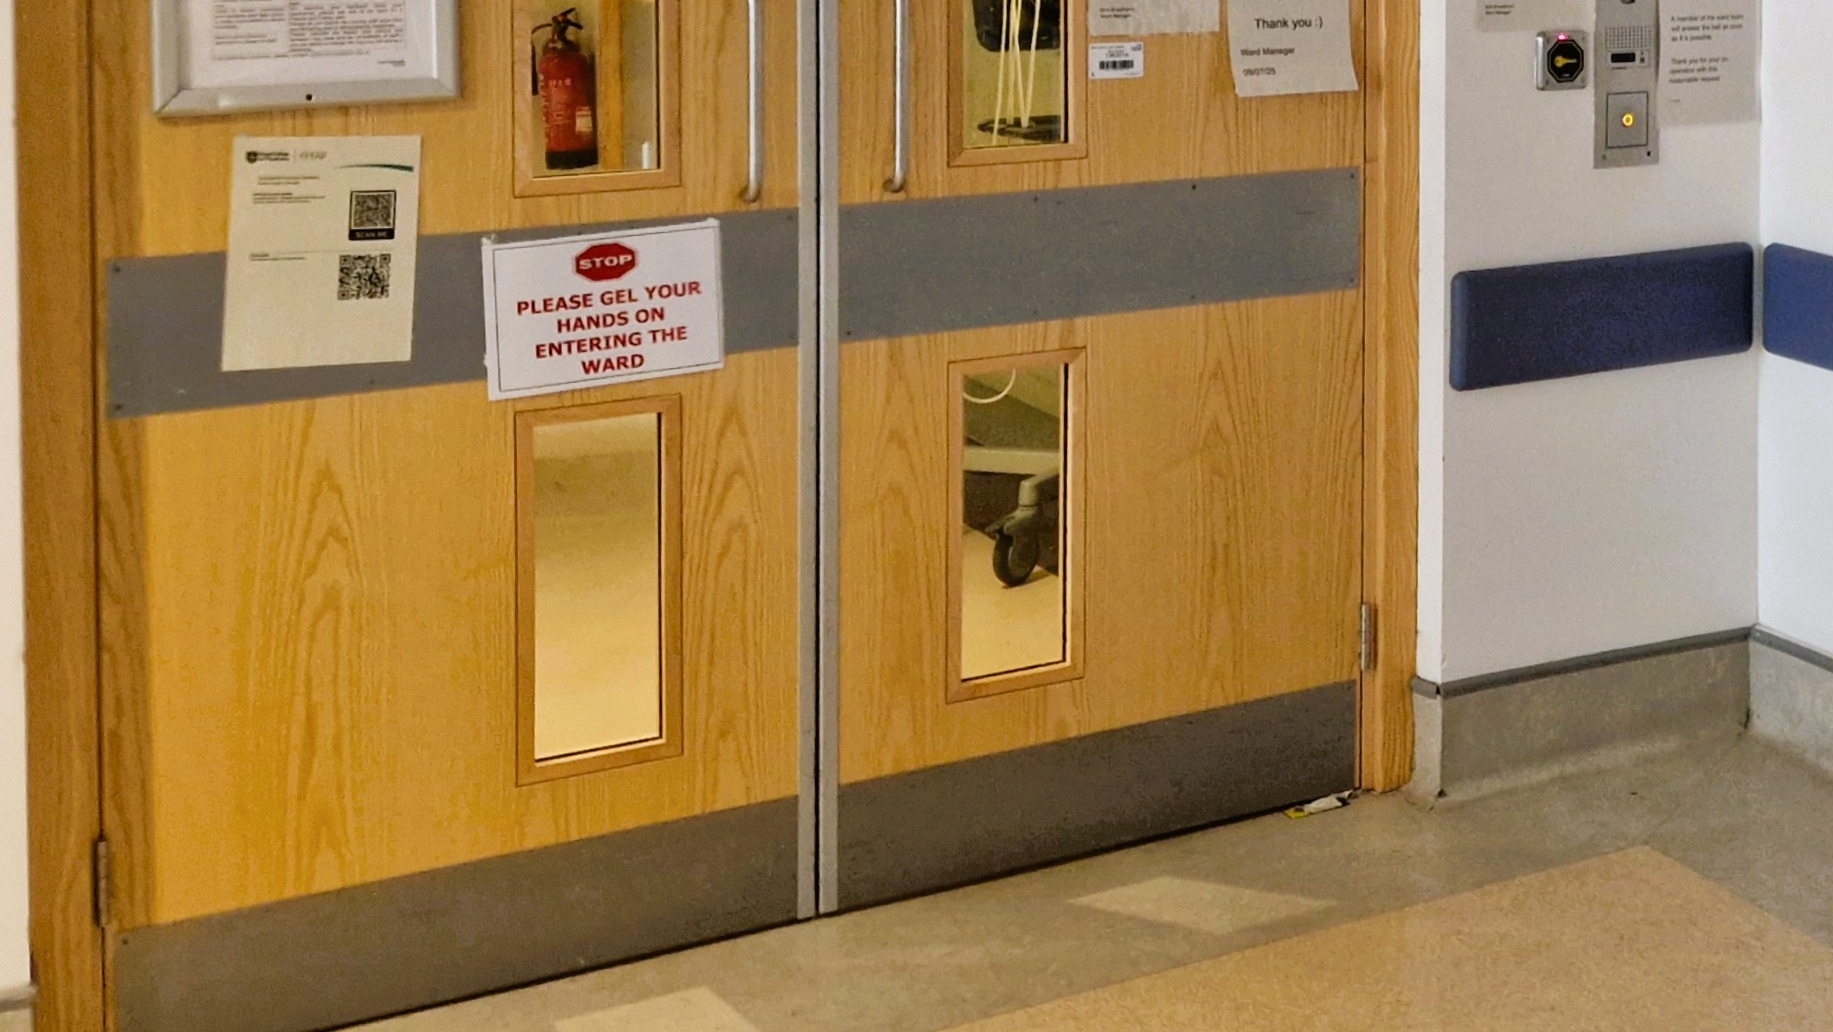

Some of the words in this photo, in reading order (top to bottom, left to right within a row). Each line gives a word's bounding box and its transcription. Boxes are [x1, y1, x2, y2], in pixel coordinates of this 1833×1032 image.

[1254, 18, 1289, 30] Thank
[1292, 19, 1312, 30] you
[578, 253, 633, 270] STOP
[517, 293, 593, 316] PLEASE
[600, 289, 638, 306] GEL
[645, 281, 702, 301] YOUR
[557, 311, 629, 333] HANDS
[635, 307, 665, 324] ON
[535, 332, 642, 359] ENTERING
[648, 326, 688, 344] THE
[581, 354, 645, 375] WARD
